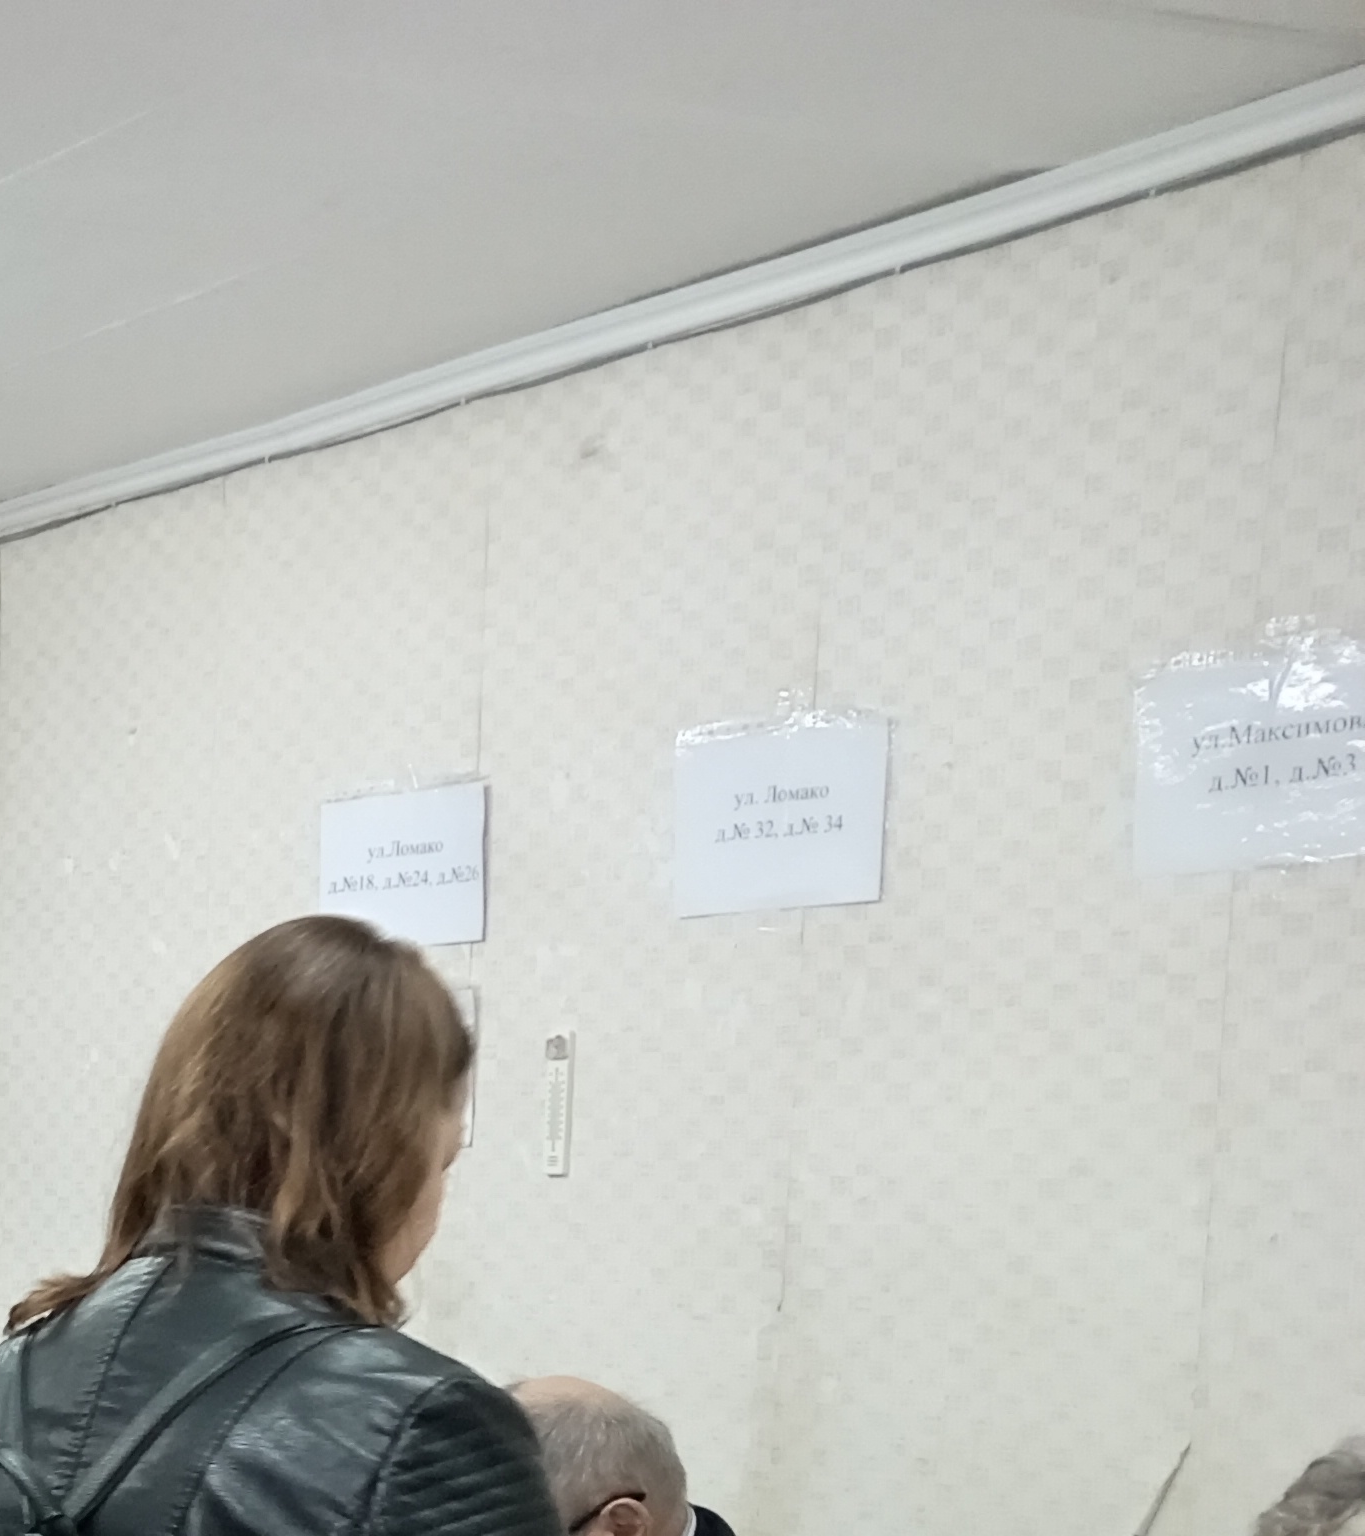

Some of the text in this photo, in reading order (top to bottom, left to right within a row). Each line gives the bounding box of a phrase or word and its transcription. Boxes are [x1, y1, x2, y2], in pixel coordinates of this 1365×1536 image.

[1191, 714, 1365, 758] ул.Максимов
[733, 784, 830, 811] ул. Ломако
[823, 815, 844, 833] 34
